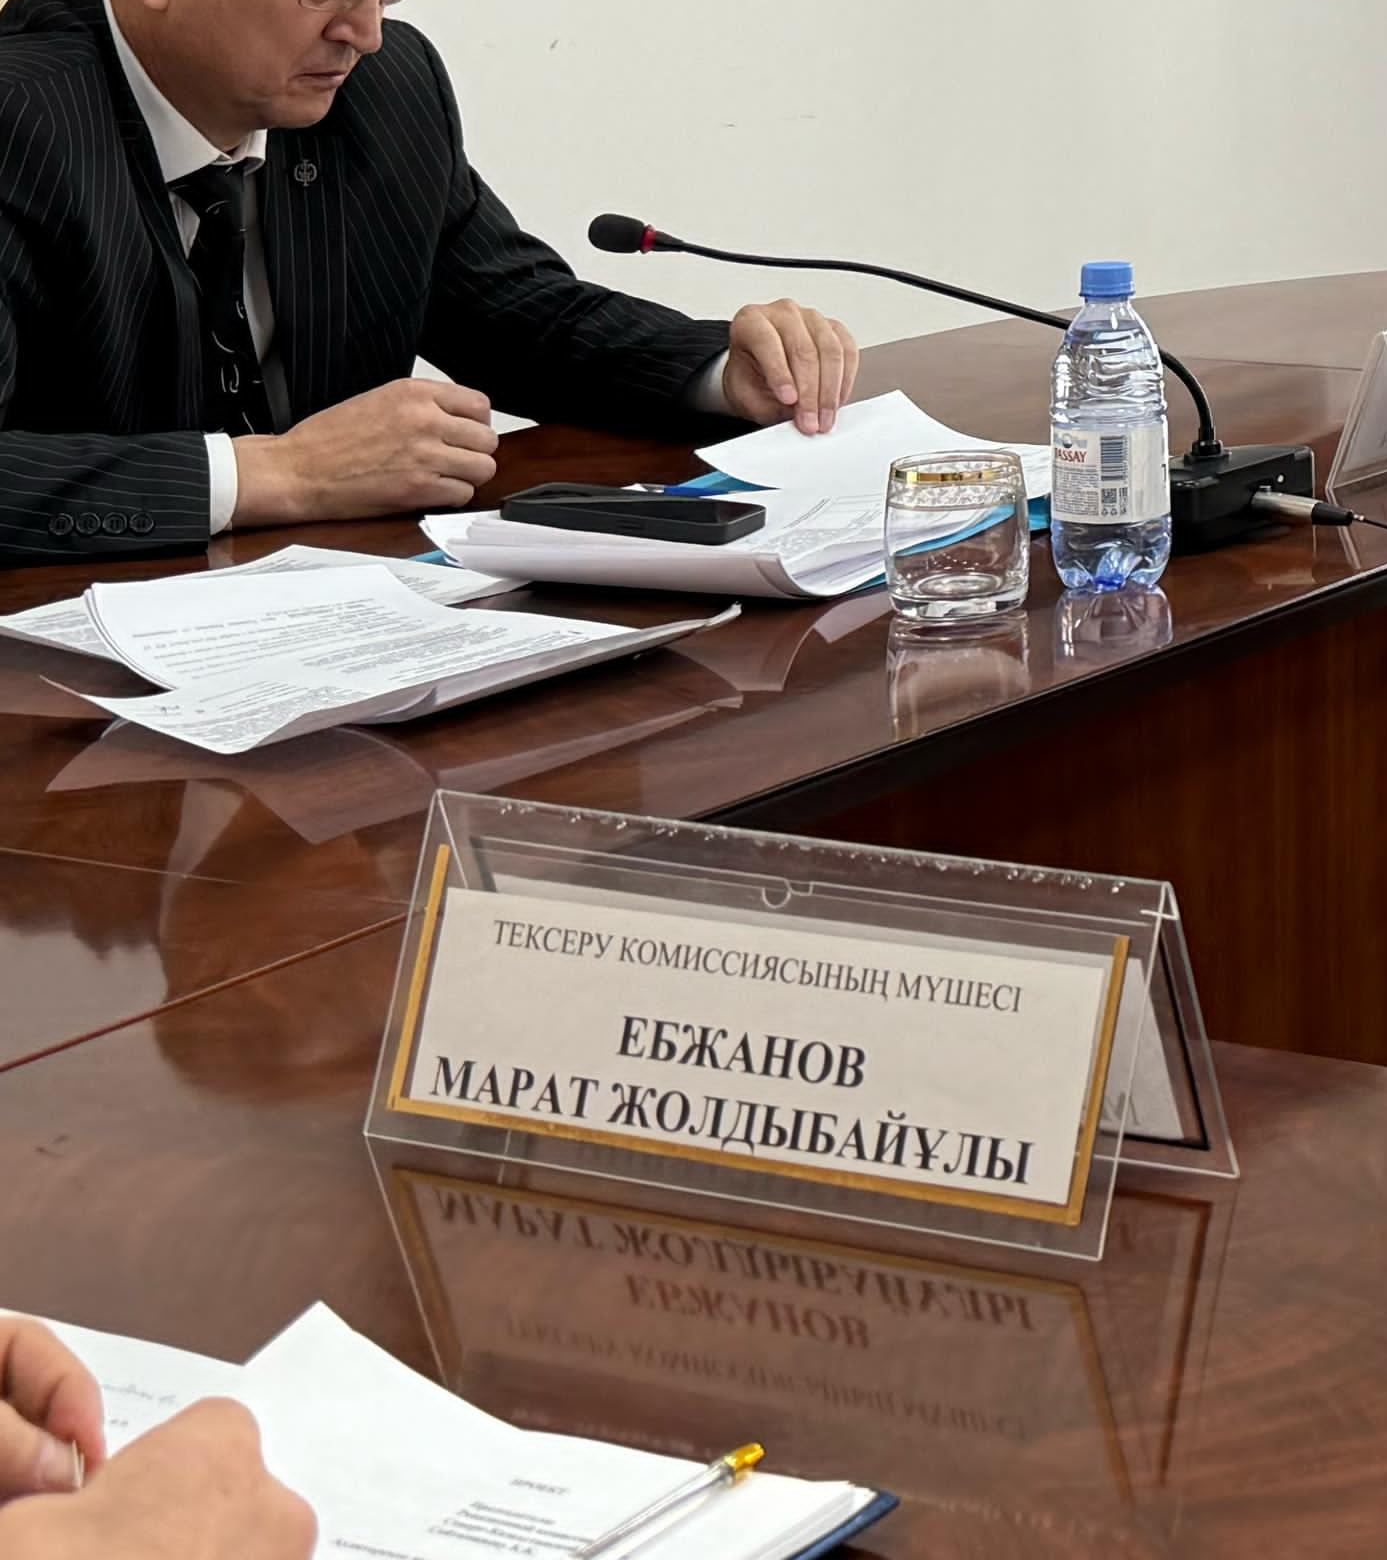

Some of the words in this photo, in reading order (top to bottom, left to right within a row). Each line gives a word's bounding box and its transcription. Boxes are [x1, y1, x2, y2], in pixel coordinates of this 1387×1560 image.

[492, 919, 615, 961] ТЕКСЕРУ
[619, 936, 891, 1003] КОМИССИЯСЫНЫҢ
[897, 970, 1023, 1015] МҮШЕСІ
[617, 1014, 868, 1089] ЕБЖАНОВ
[428, 1054, 602, 1116] МАРАТ
[606, 1081, 1035, 1186] ЖОЛДЫБАЙҰЛЫ
